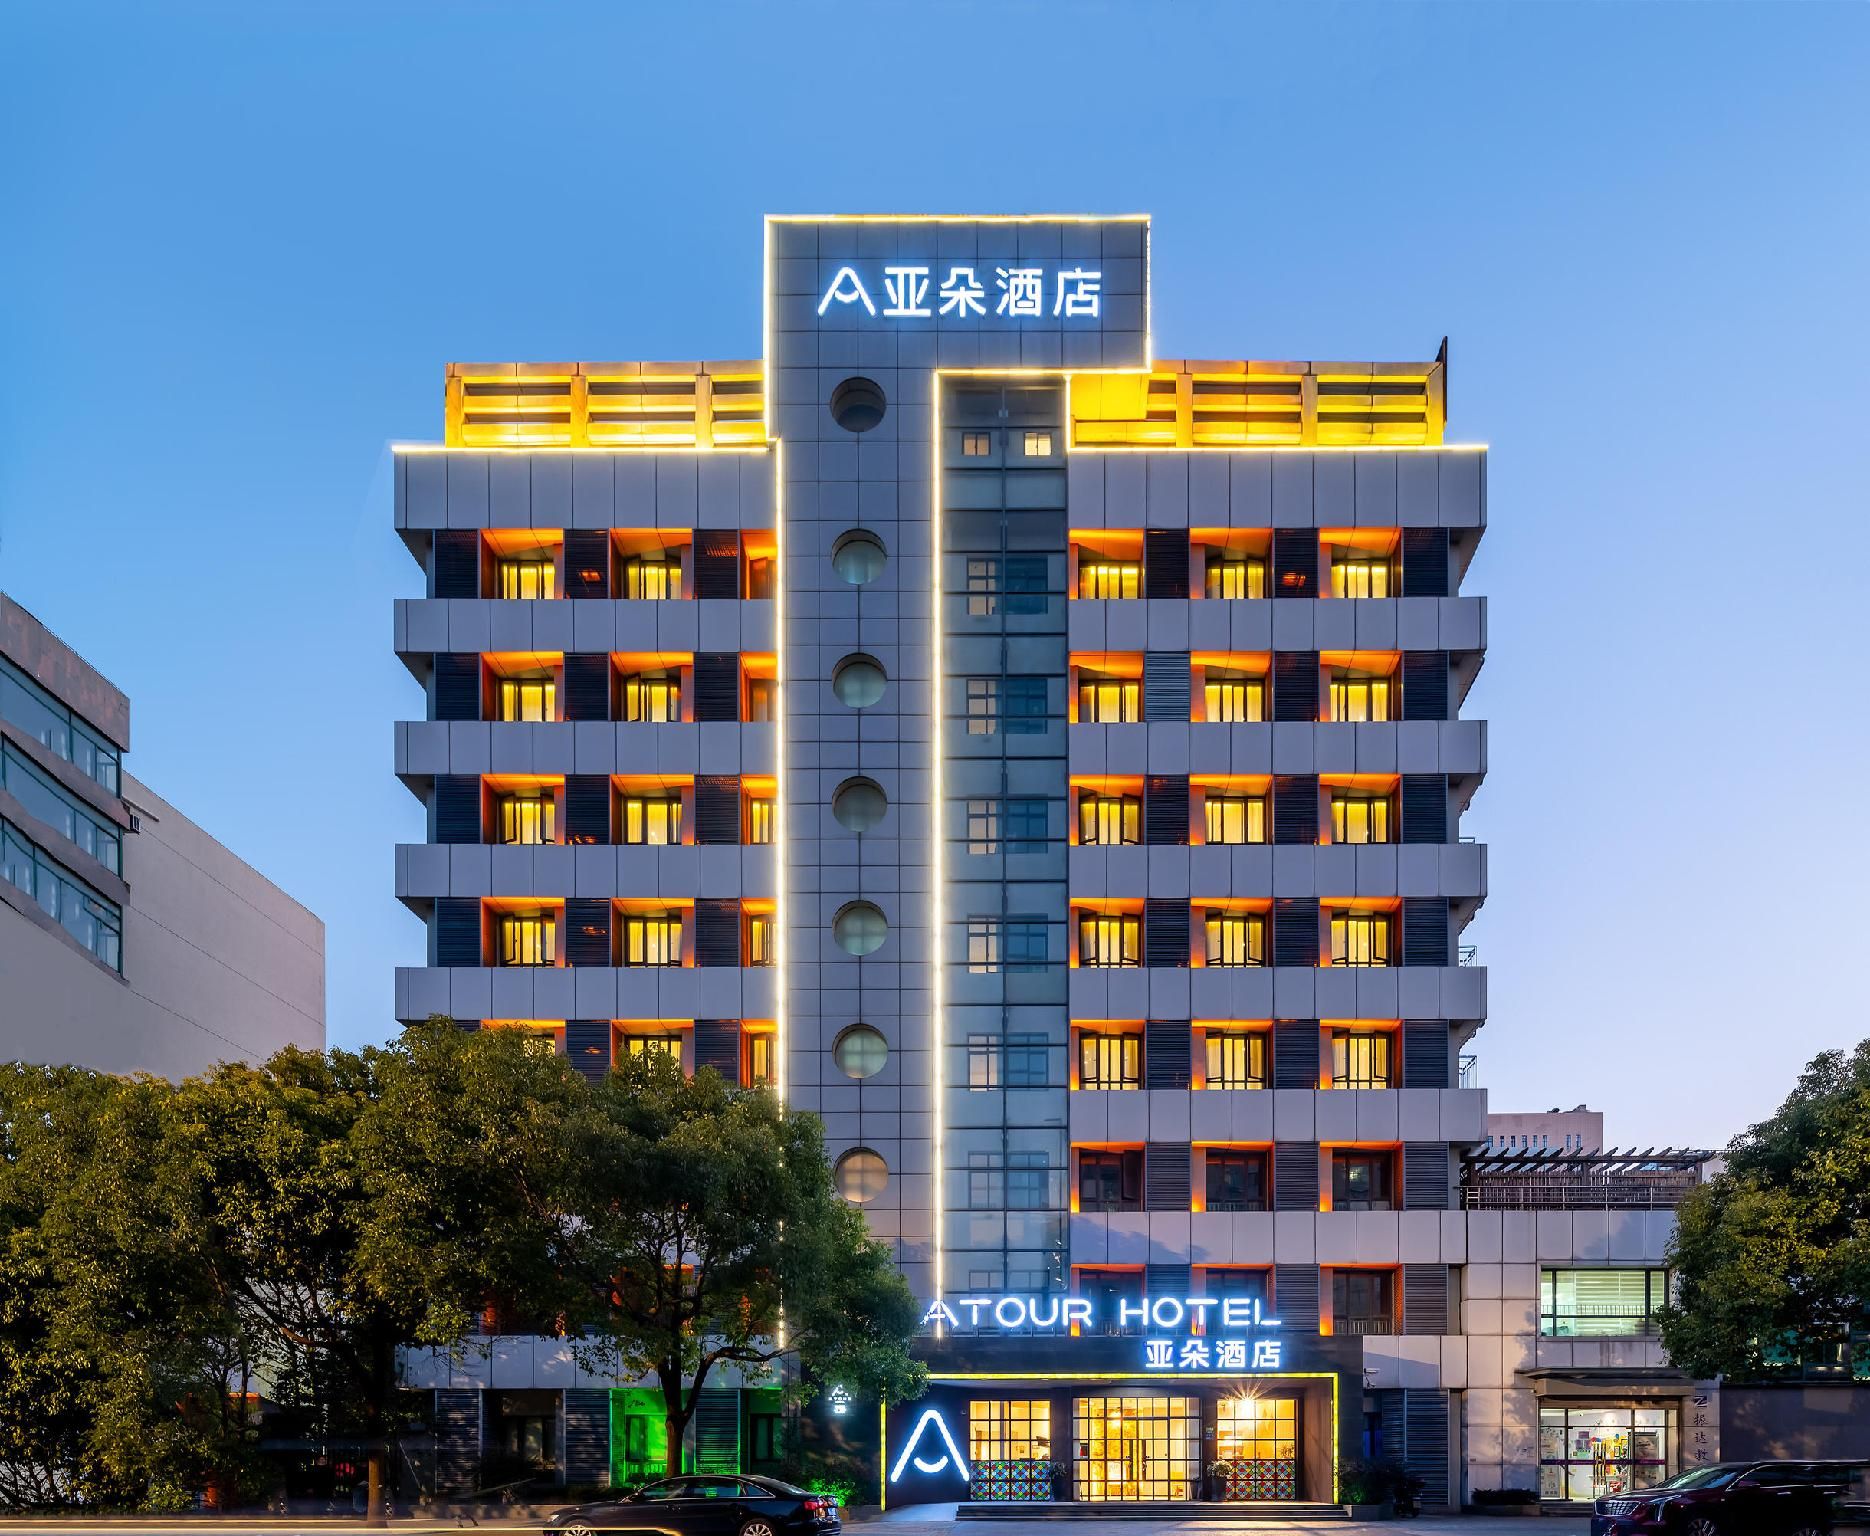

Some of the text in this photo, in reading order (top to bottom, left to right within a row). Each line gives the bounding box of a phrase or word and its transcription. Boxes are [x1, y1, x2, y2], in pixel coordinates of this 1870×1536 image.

[883, 266, 1102, 318] 亚朵酒店
[920, 1297, 1282, 1328] ATOUR HOTEL
[1145, 1339, 1282, 1369] 亚朵酒店
